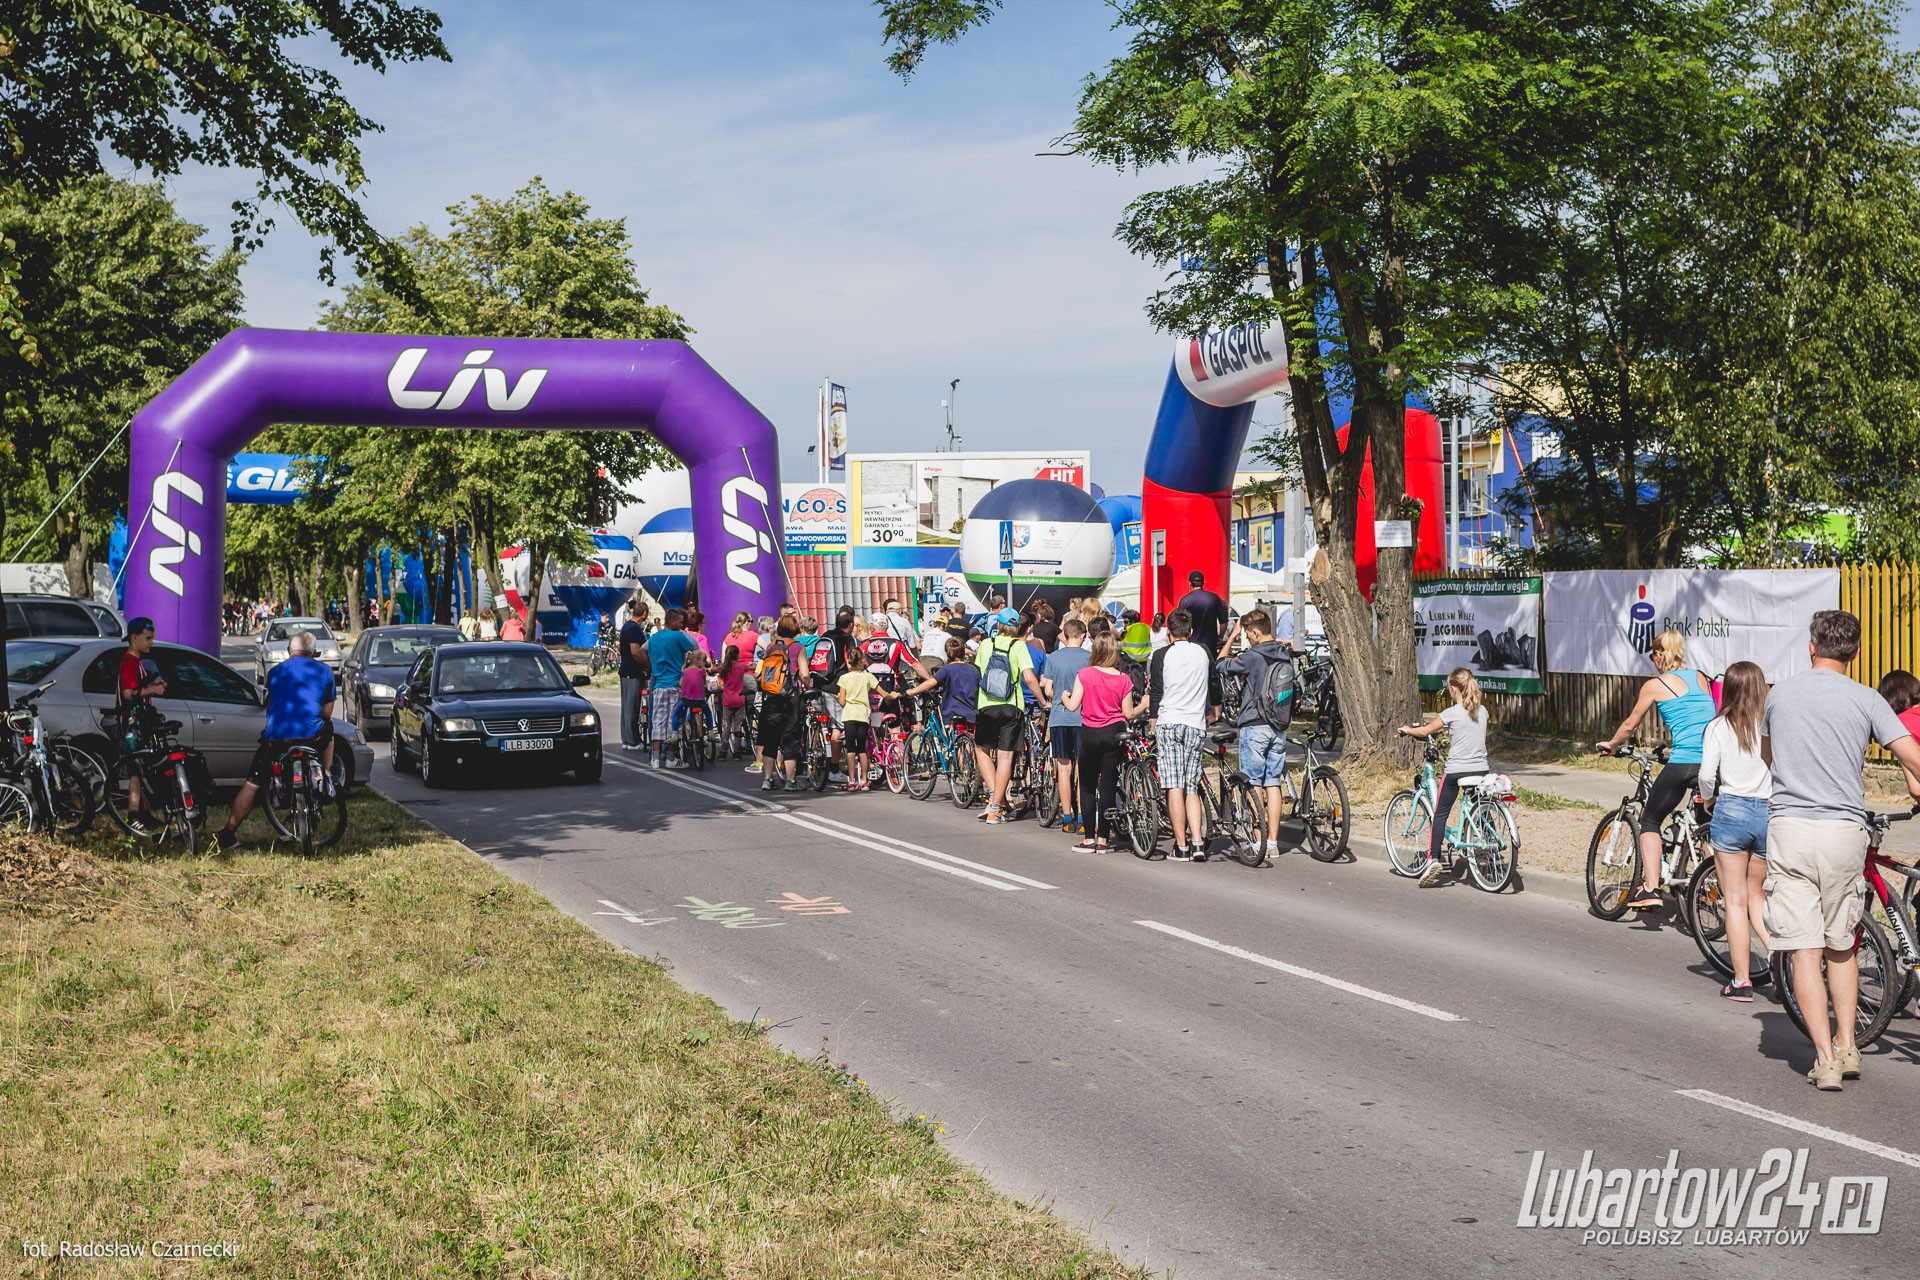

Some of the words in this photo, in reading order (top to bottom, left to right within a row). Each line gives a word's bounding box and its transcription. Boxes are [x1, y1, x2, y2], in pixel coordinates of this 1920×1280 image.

[386, 347, 549, 411] Liv
[1050, 469, 1076, 483] HIT
[148, 471, 205, 597] Liv
[722, 475, 769, 594] Liv
[1464, 580, 1505, 594] dystrybutor
[1506, 580, 1530, 594] węgla
[1696, 617, 1731, 638] Polski
[505, 740, 523, 751] LLB
[524, 739, 553, 750] 33090
